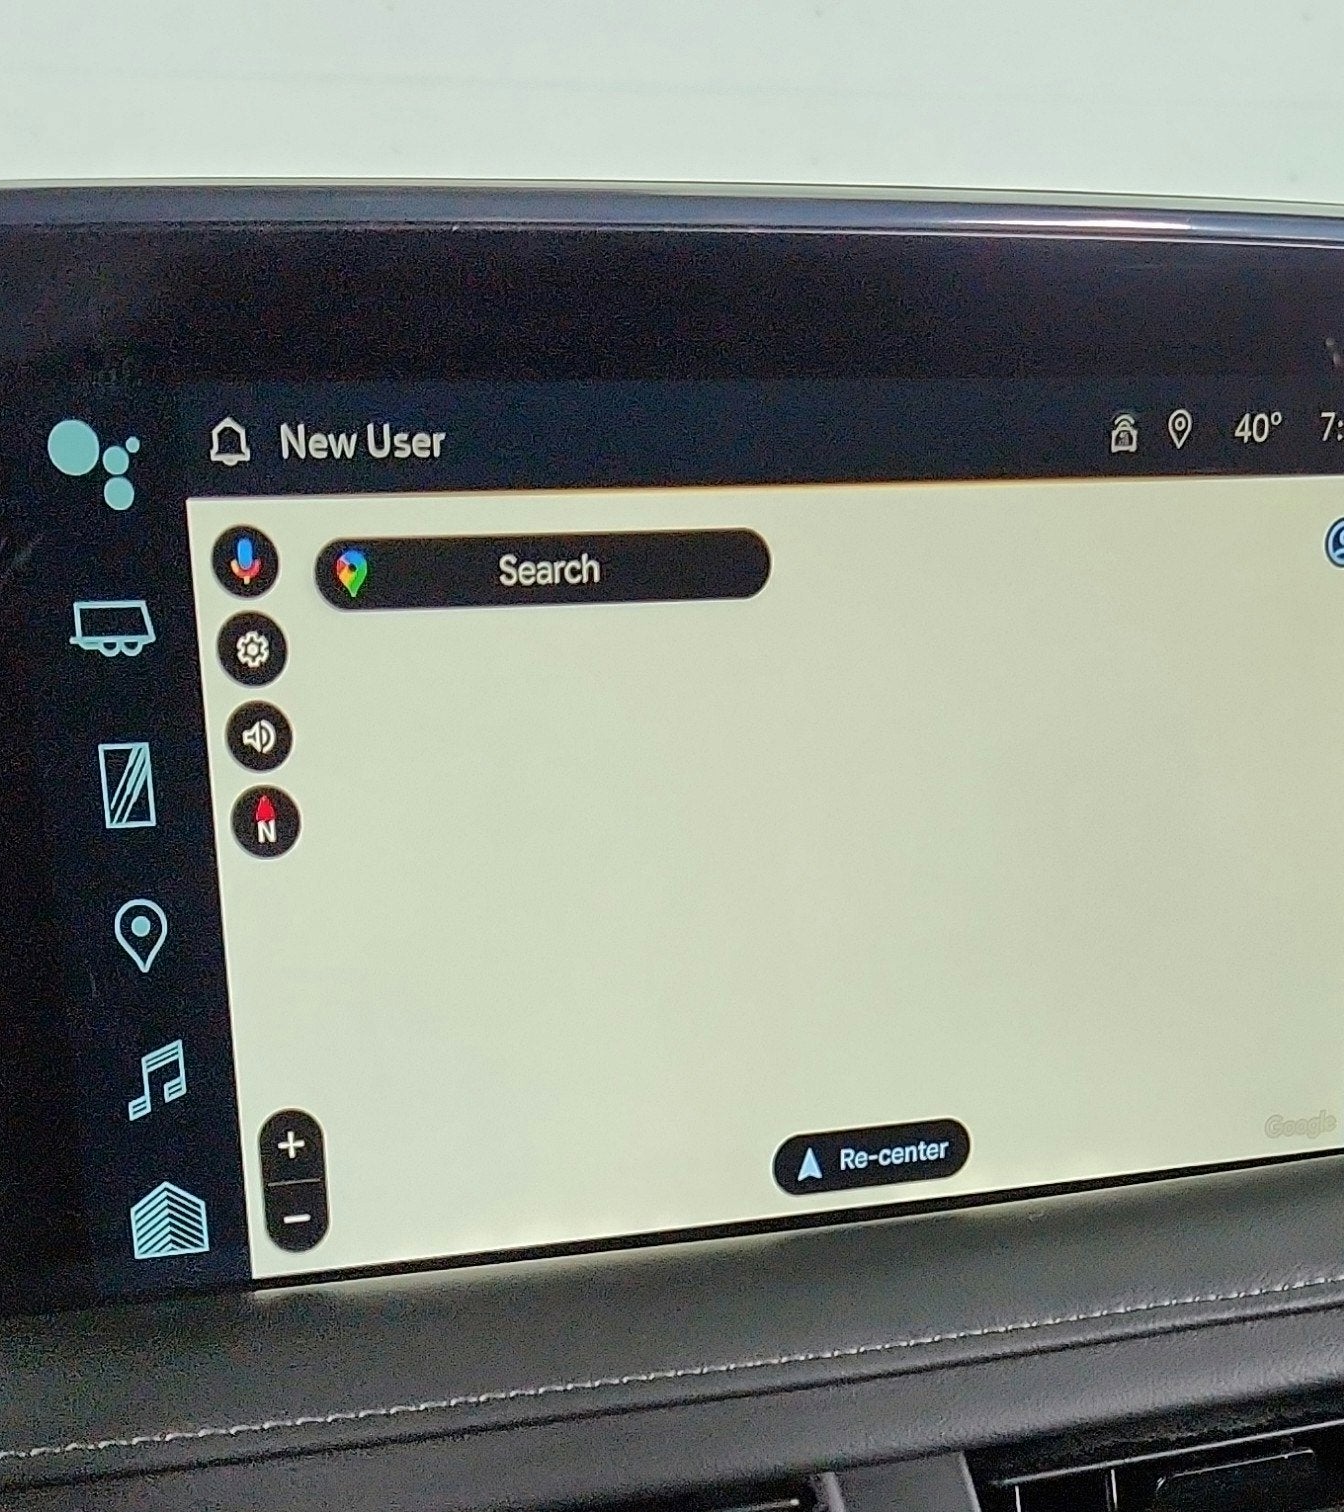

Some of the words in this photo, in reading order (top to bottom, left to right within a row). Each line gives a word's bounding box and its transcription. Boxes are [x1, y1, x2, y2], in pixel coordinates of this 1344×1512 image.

[281, 423, 356, 459] New
[368, 423, 446, 459] User
[1234, 411, 1283, 443] 40°
[499, 552, 600, 586] Search
[256, 821, 277, 843] N
[1264, 1109, 1337, 1139] Google
[839, 1138, 949, 1172] Re-center
